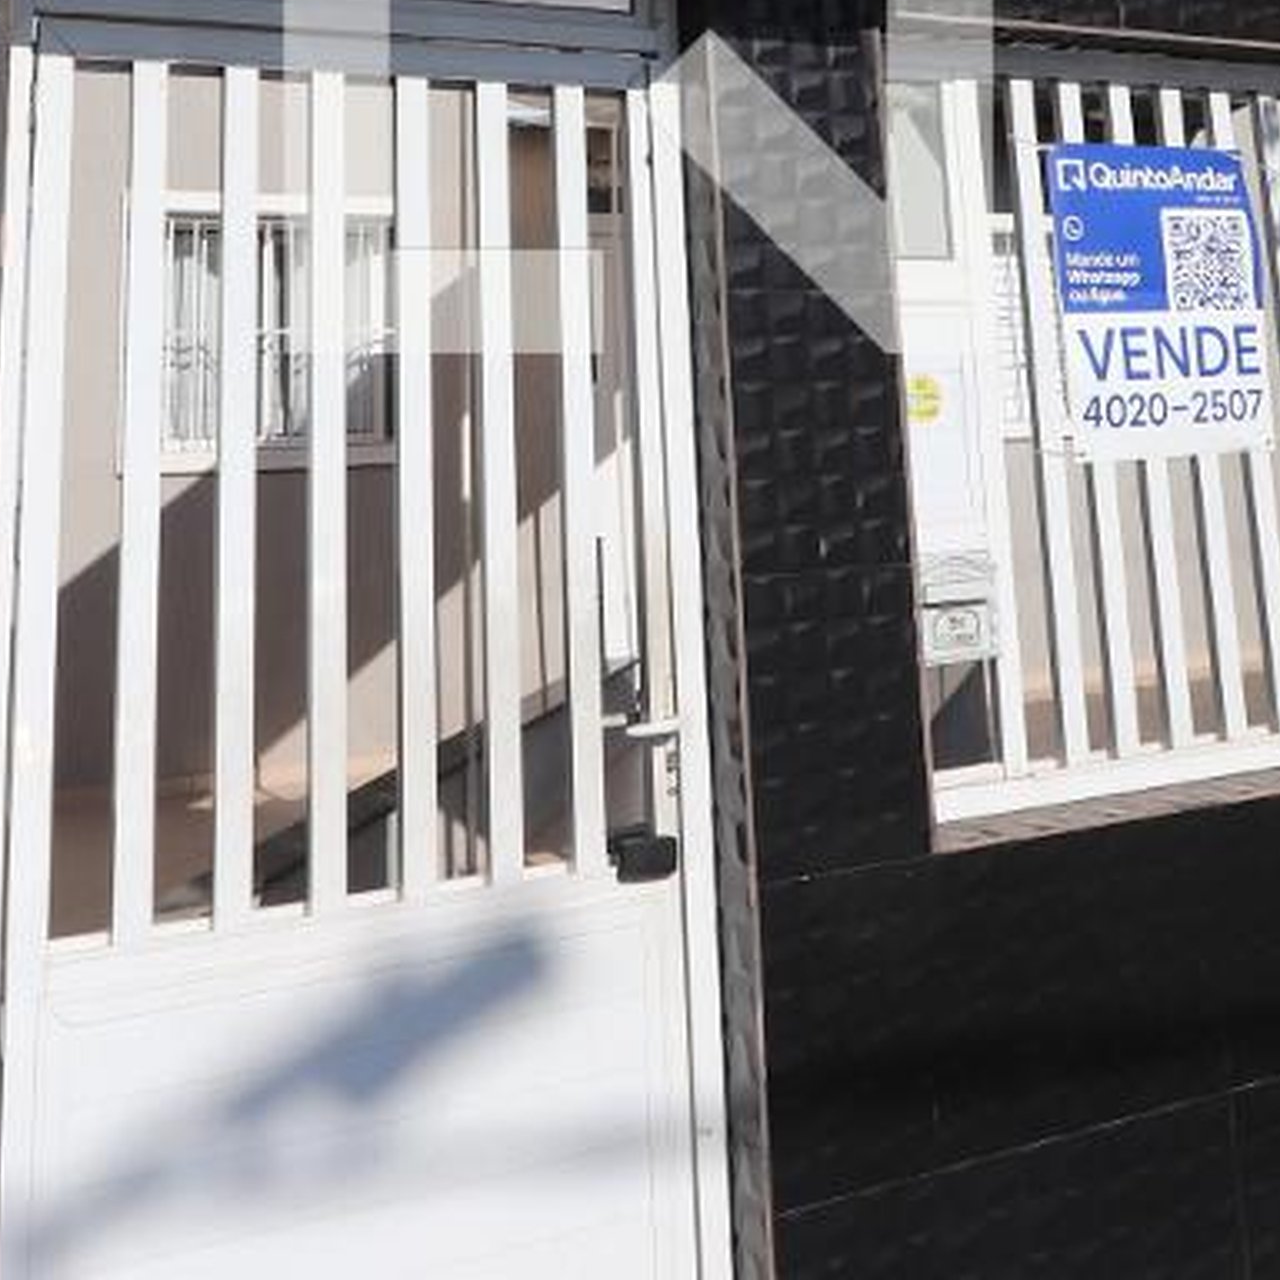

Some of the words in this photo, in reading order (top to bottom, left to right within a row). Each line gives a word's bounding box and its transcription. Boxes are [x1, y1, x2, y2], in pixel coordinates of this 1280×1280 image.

[1089, 161, 1238, 192] QuintoAndar
[1077, 325, 1261, 381] VENDE
[1083, 388, 1263, 428] 4020-2507
